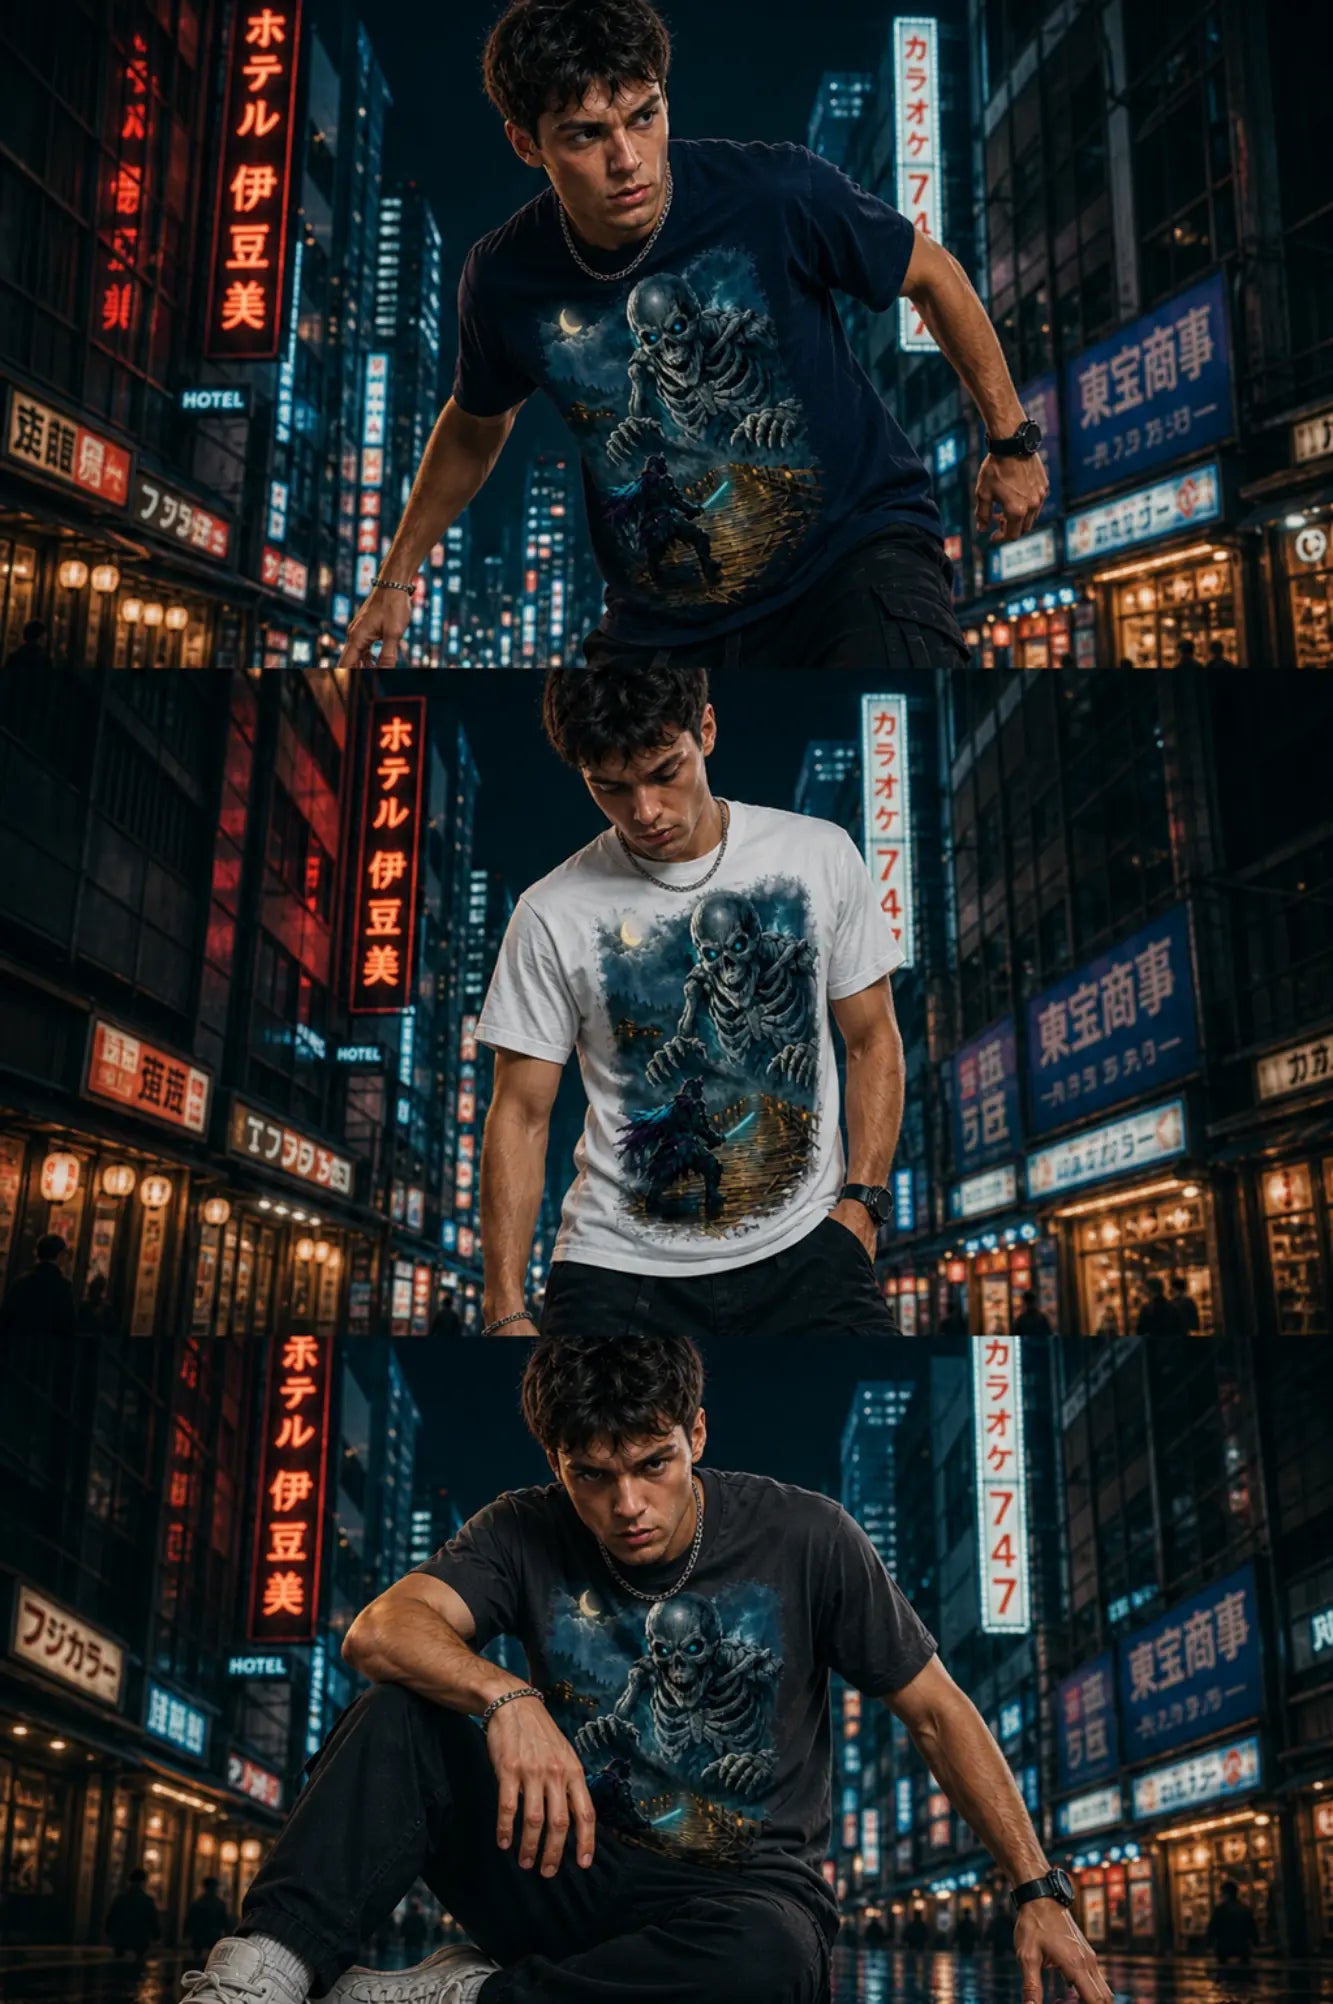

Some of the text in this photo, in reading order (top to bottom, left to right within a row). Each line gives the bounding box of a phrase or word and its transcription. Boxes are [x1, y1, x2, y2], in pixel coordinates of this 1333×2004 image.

[904, 35, 928, 156] カラオケ
[221, 8, 286, 330] ホテル 伊豆美
[182, 391, 244, 409] HOTEL
[1078, 304, 1216, 430] 東宝商事
[873, 711, 899, 831] カラオケ
[363, 716, 413, 986] ホテル 伊豆美
[336, 1046, 381, 1062] HOTEL
[1038, 937, 1174, 1066] 東宝商事
[985, 1339, 1016, 1614] カラオケ 747
[263, 1469, 314, 1616] 伊豆美
[22, 1600, 117, 1678] フジカラー
[229, 1656, 287, 1675] HOTEL
[1128, 1589, 1250, 1702] 東宝商事
